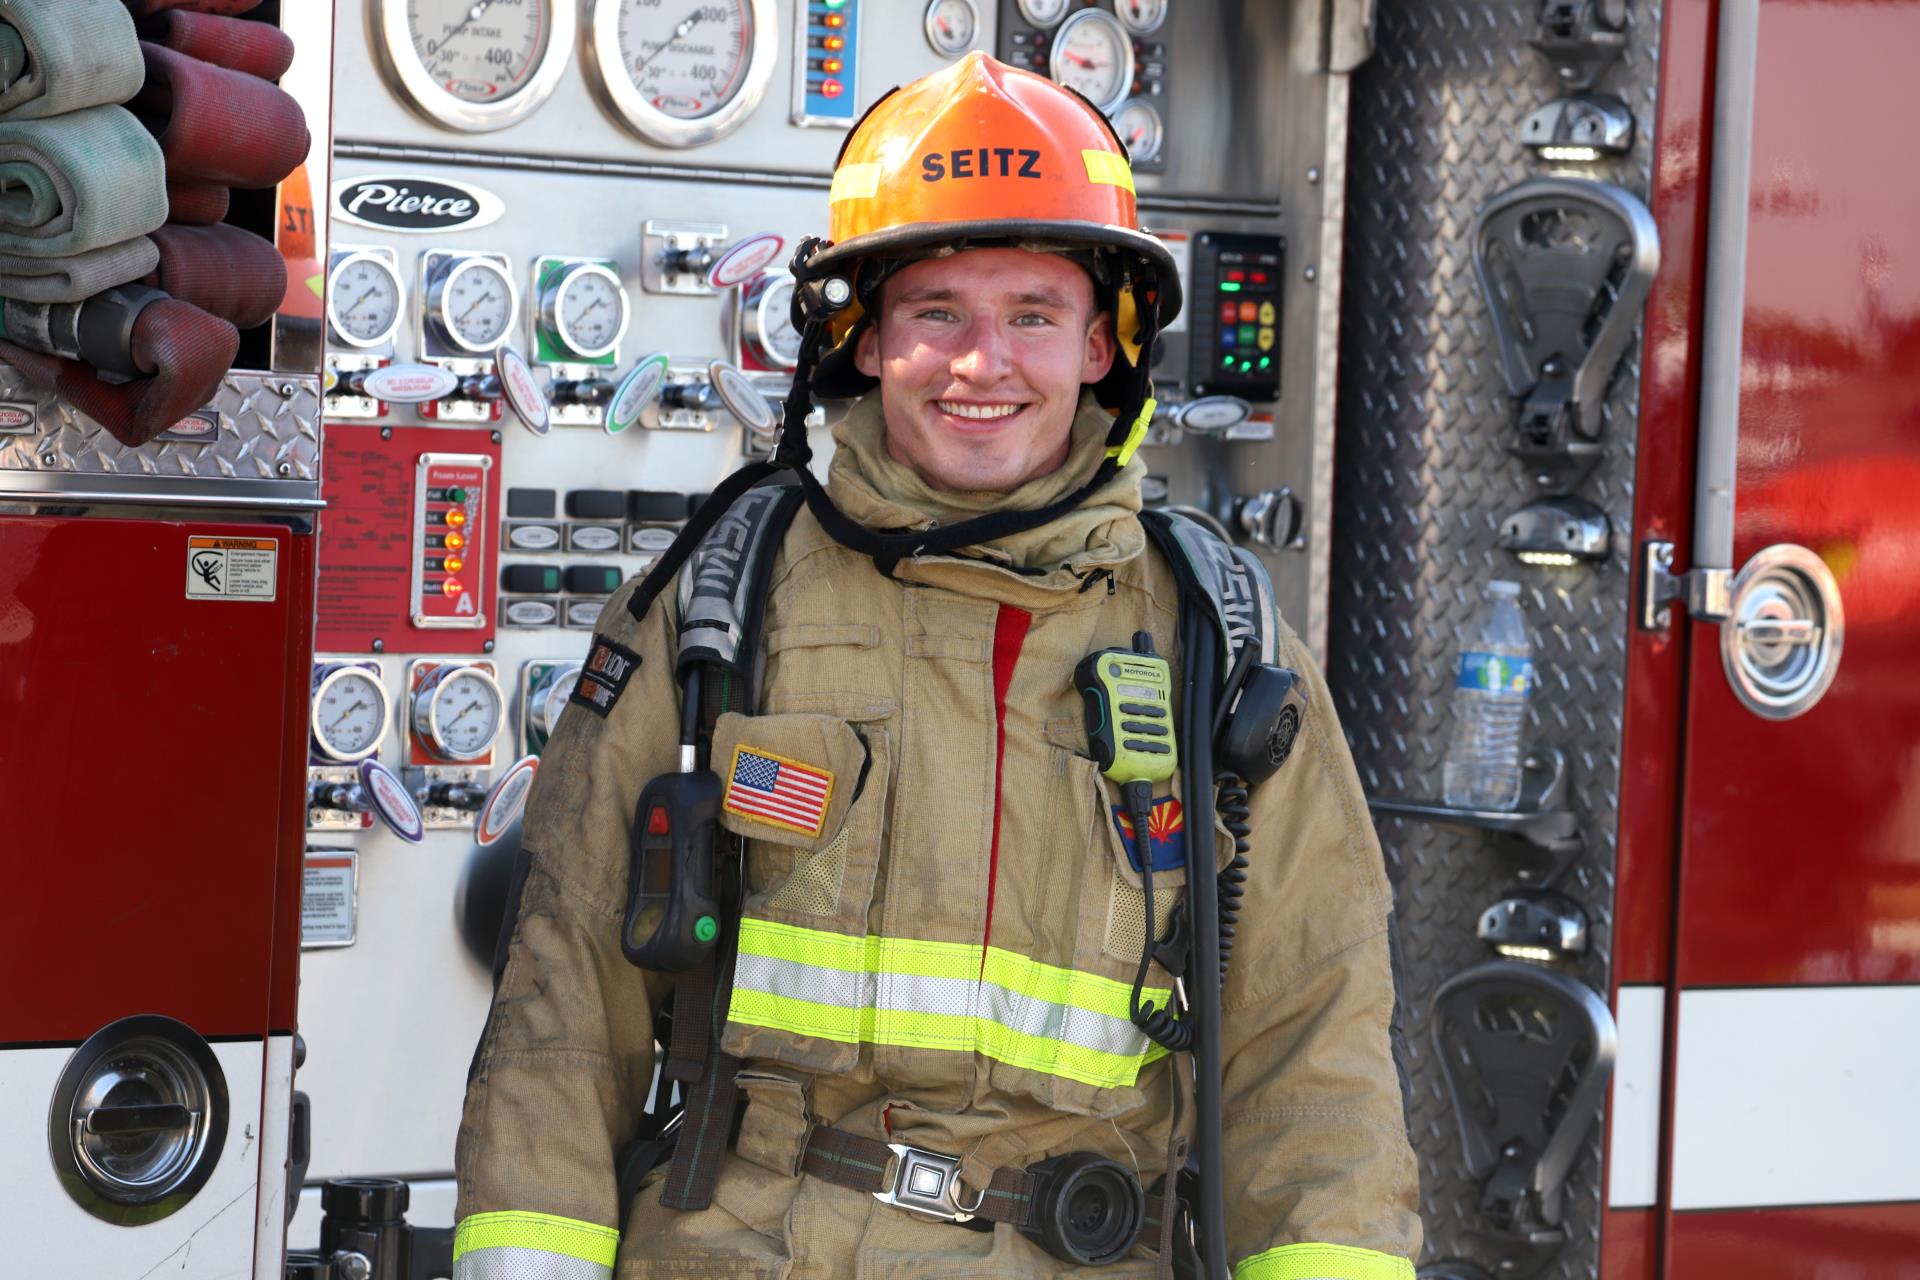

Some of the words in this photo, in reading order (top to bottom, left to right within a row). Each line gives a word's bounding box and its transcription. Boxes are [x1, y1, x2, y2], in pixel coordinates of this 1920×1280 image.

[471, 28, 502, 38] INTAKE
[485, 48, 512, 65] 400
[691, 64, 717, 81] 400
[922, 148, 1042, 182] SEITZ
[348, 183, 473, 217] Pierce
[433, 470, 454, 480] Foam
[455, 471, 478, 480] Level
[223, 539, 257, 549] WARNING
[455, 591, 474, 614] A
[602, 651, 629, 681] LION
[1124, 668, 1161, 678] MOTOROLA
